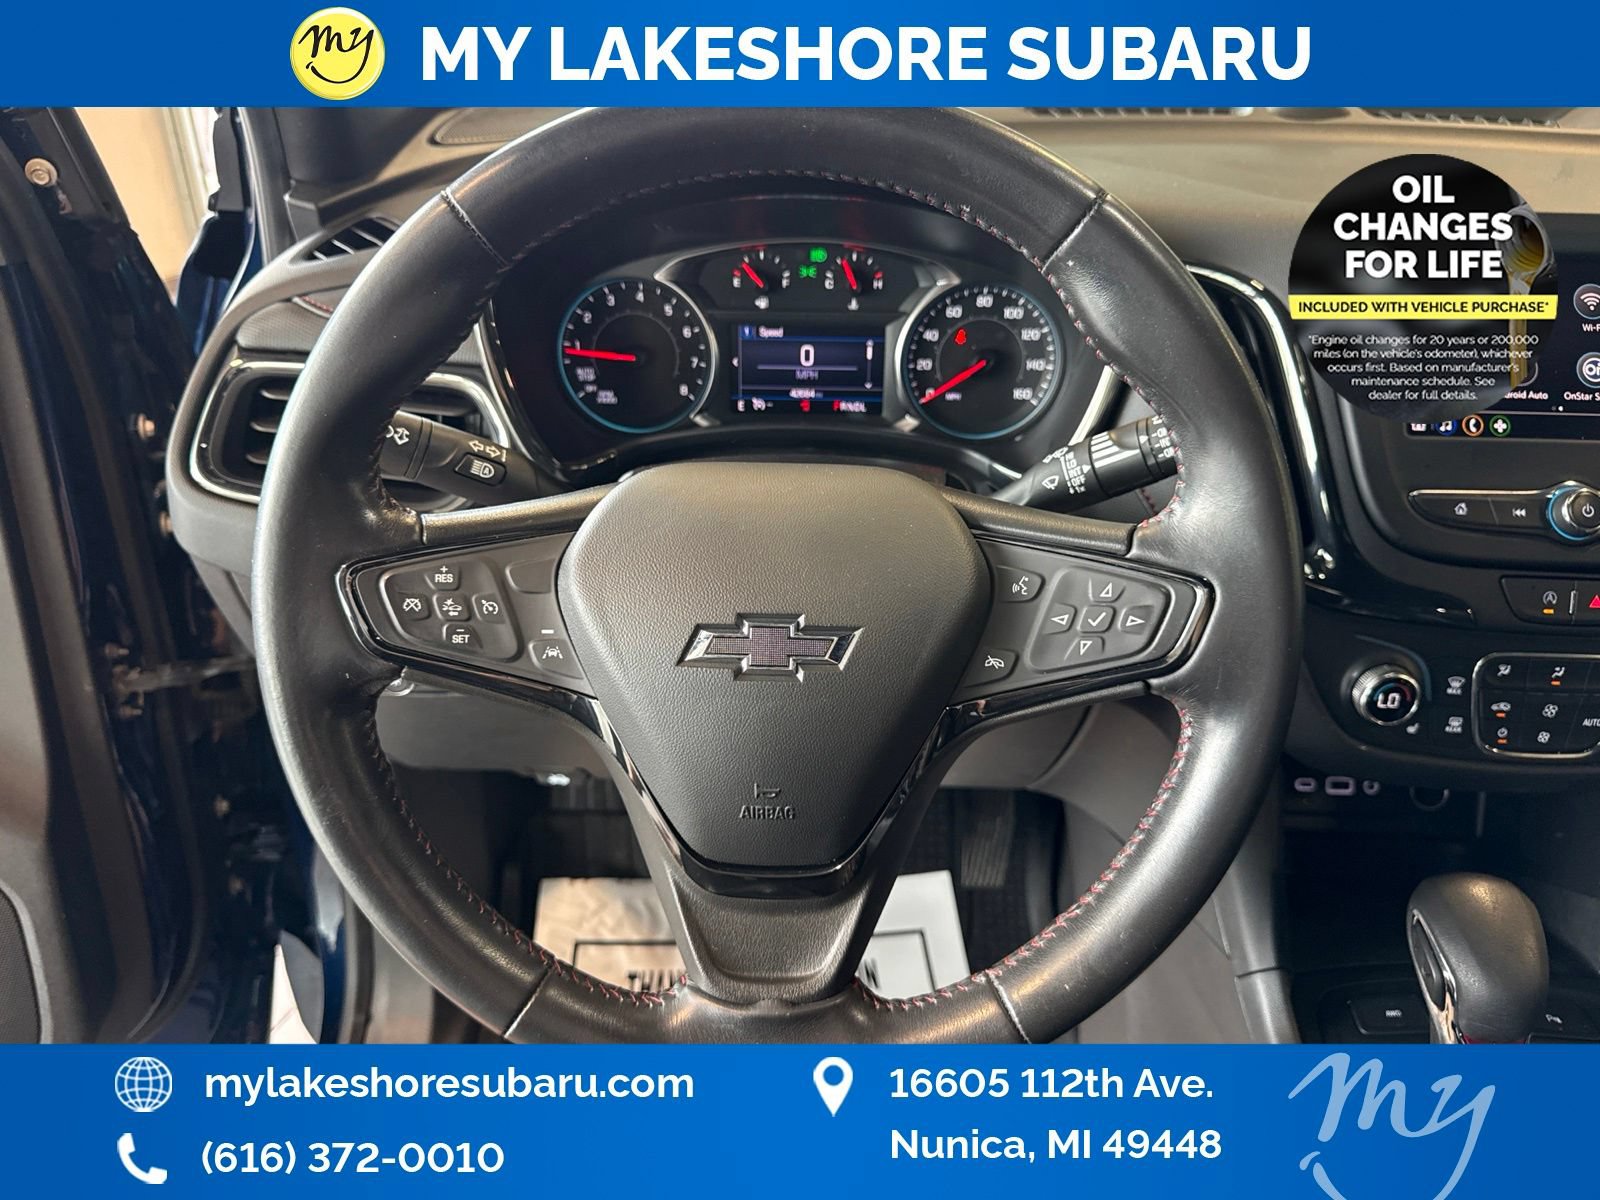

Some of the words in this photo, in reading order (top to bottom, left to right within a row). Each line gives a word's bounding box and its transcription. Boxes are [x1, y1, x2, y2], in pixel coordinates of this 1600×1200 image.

[976, 295, 994, 308] 80
[946, 305, 963, 318] 60
[1003, 306, 1024, 319] 100
[1582, 323, 1600, 332] Wi-F
[922, 328, 939, 341] 40
[1021, 328, 1041, 341] 120
[800, 344, 815, 367] 0
[916, 358, 933, 371] 20
[1026, 358, 1046, 371] 140
[1013, 388, 1033, 400] 160
[1528, 391, 1549, 400] Auto
[1563, 391, 1593, 401] OnStar
[1071, 474, 1085, 487] OFF
[434, 574, 453, 583] RES
[452, 634, 470, 644] SET
[1377, 692, 1400, 709] LO
[739, 805, 795, 819] AIRBAG
